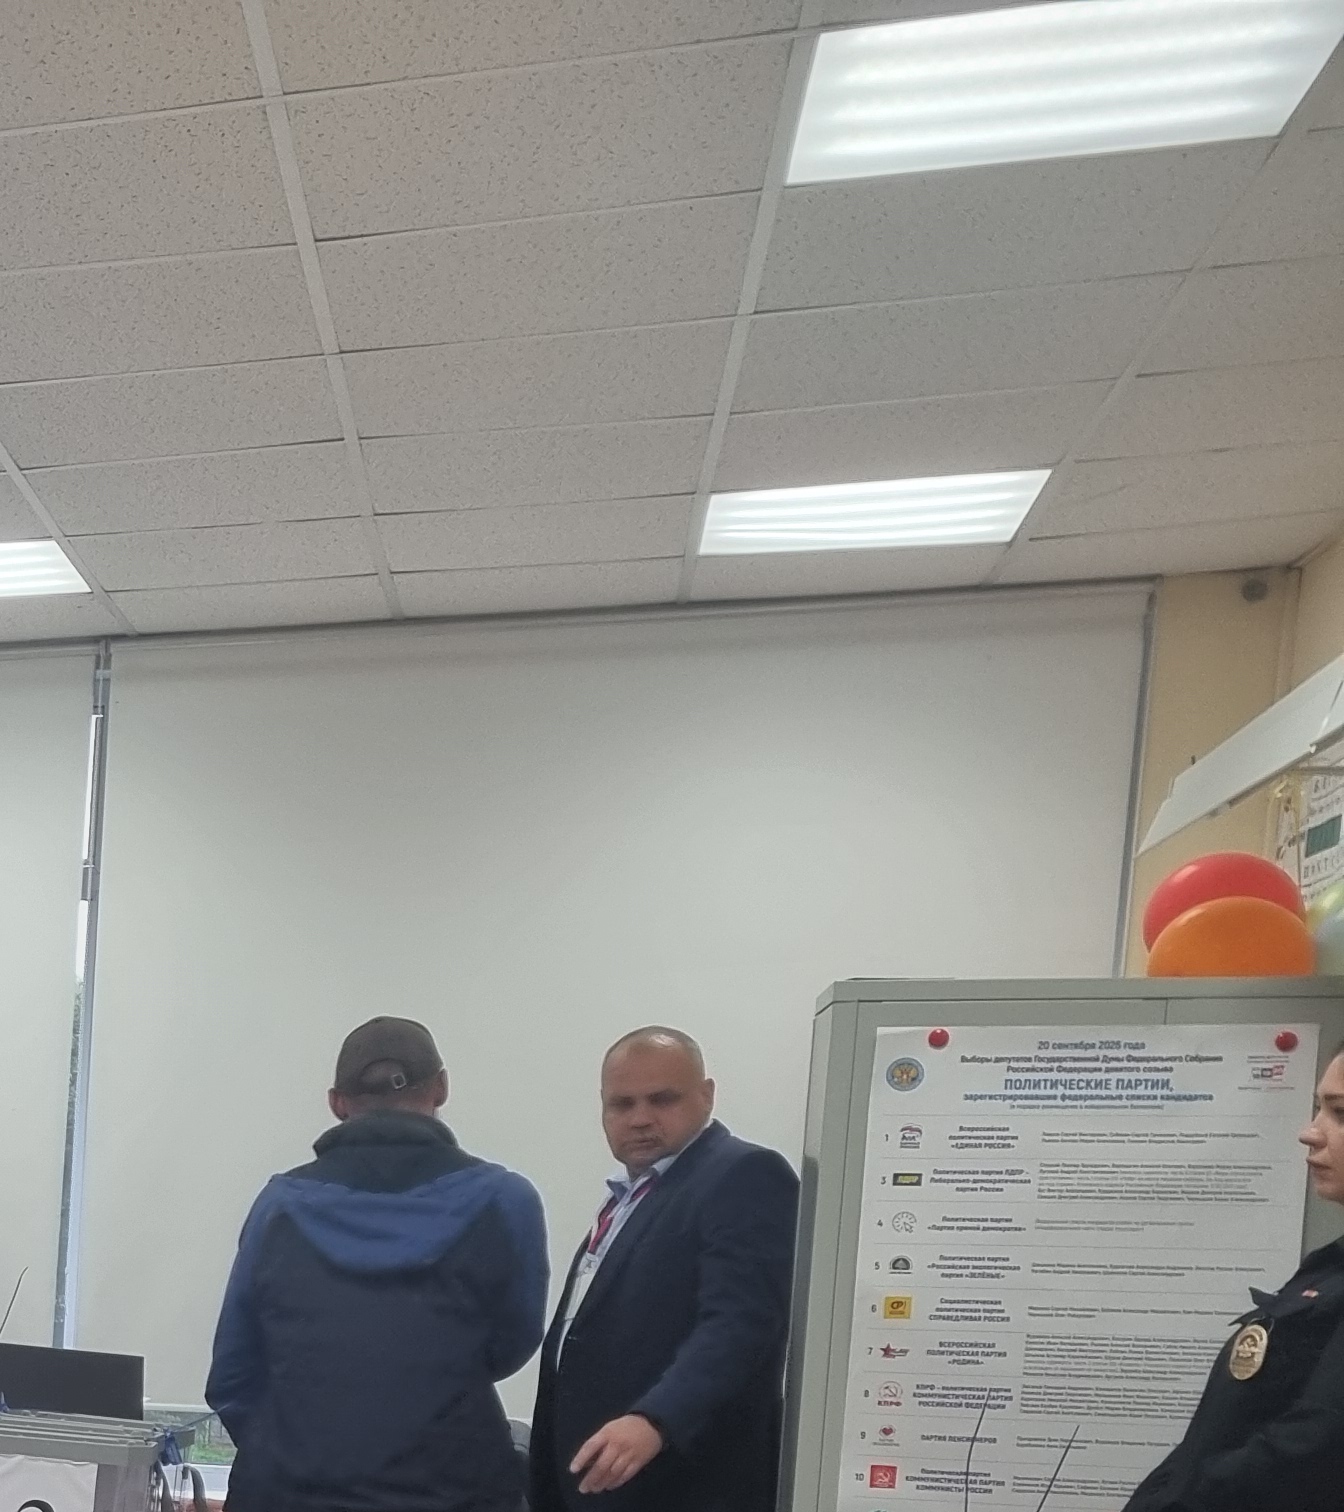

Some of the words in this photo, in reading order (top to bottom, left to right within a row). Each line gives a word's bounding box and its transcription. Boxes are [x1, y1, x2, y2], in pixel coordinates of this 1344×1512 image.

[1037, 1041, 1050, 1050] 20
[1052, 1041, 1096, 1052] сентября
[1123, 1041, 1146, 1051] года
[961, 1055, 992, 1064] Выборы
[1007, 1065, 1054, 1074] Российской
[1004, 1078, 1112, 1091] ПОЛИТИЧЕСКИЕ
[1115, 1078, 1174, 1092] ПАРТИИ,
